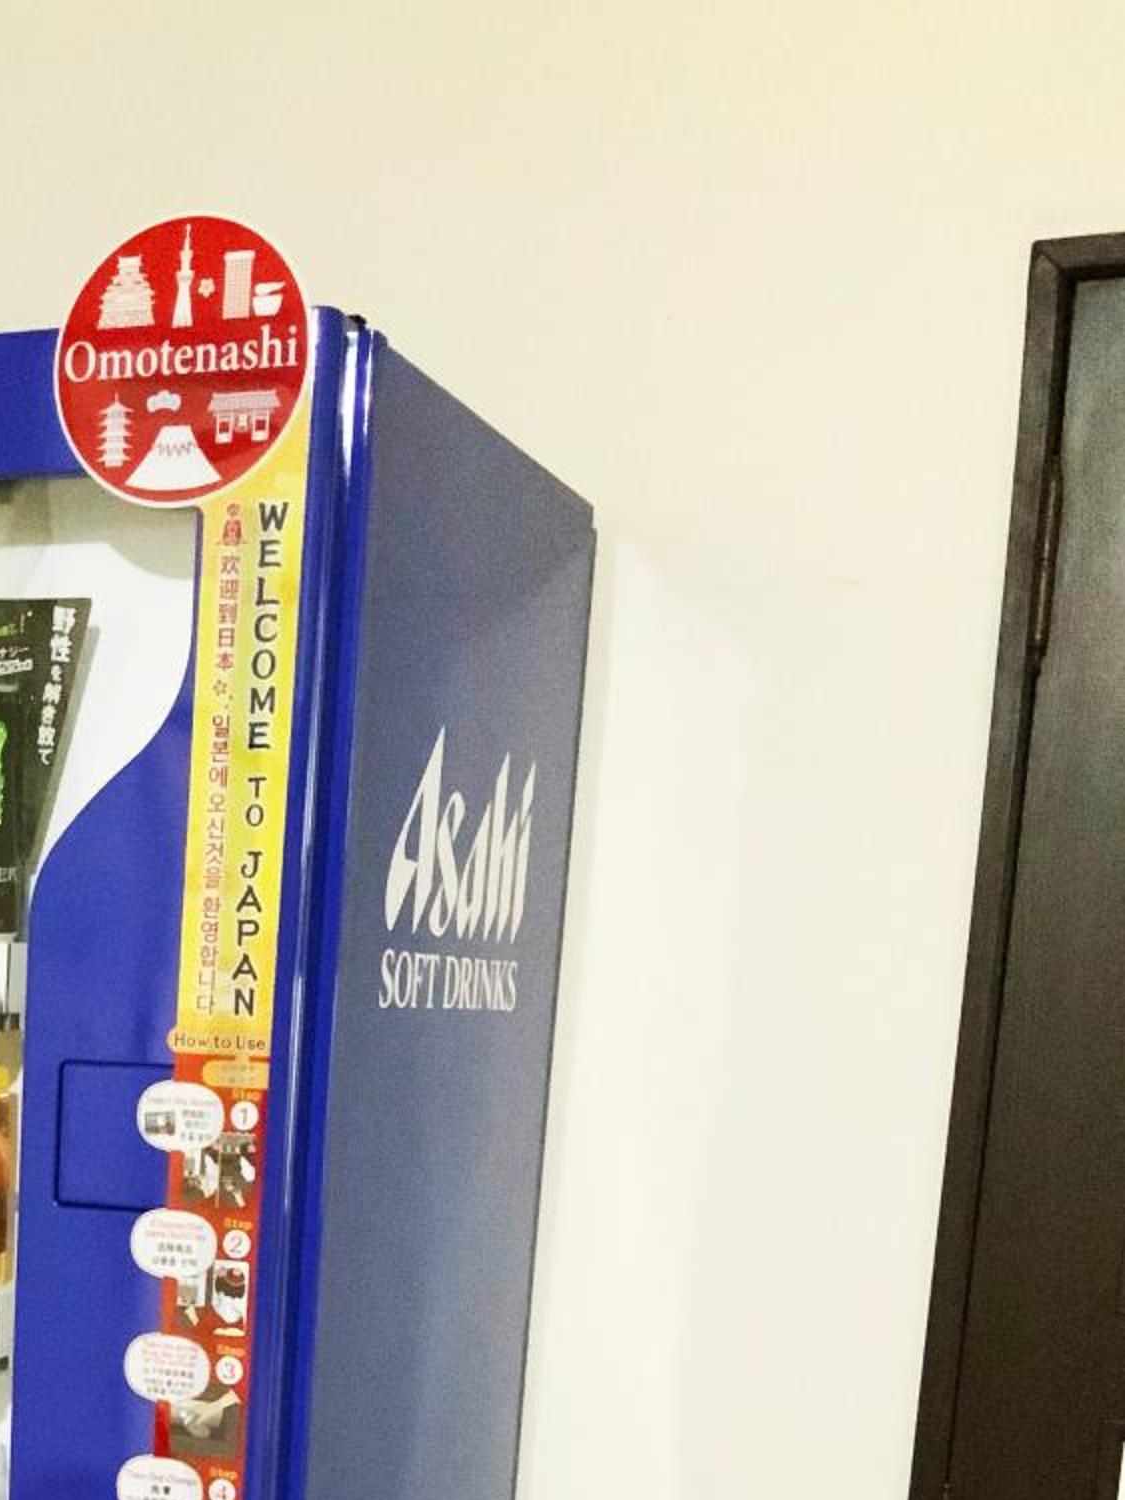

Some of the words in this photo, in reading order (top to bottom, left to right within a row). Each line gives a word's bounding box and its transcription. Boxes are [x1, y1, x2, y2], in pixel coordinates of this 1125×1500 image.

[64, 324, 299, 383] Omotenashi
[247, 501, 289, 750] WELCOME
[245, 776, 267, 827] TO
[384, 724, 536, 945] Asahi
[231, 851, 264, 1017] JAPAN
[378, 947, 440, 1010] SOFT
[441, 955, 518, 1012] DRINKS
[173, 1033, 210, 1049] How
[213, 1034, 232, 1049] to
[235, 1035, 266, 1051] Use
